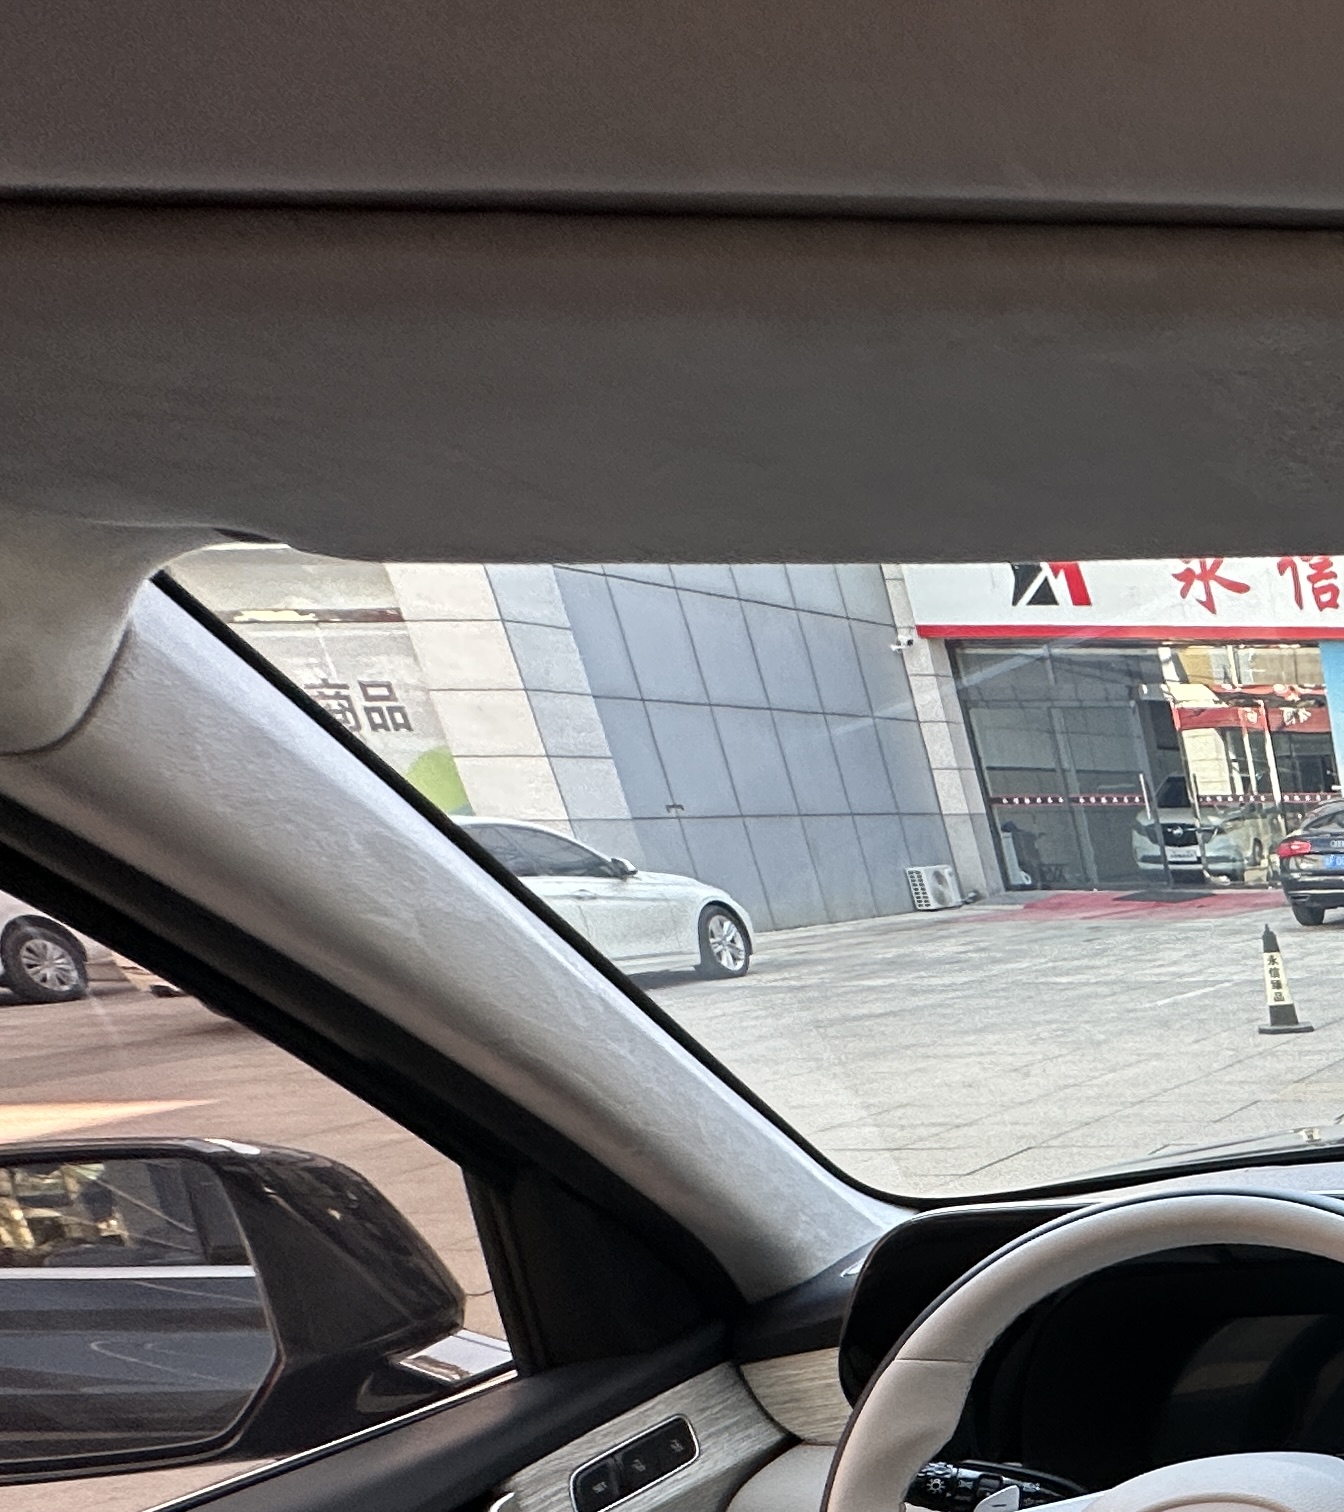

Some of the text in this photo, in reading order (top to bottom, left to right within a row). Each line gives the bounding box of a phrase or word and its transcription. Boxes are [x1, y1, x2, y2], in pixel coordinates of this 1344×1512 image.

[304, 678, 414, 732] 商品
[1267, 955, 1285, 1002] 永信臻品
